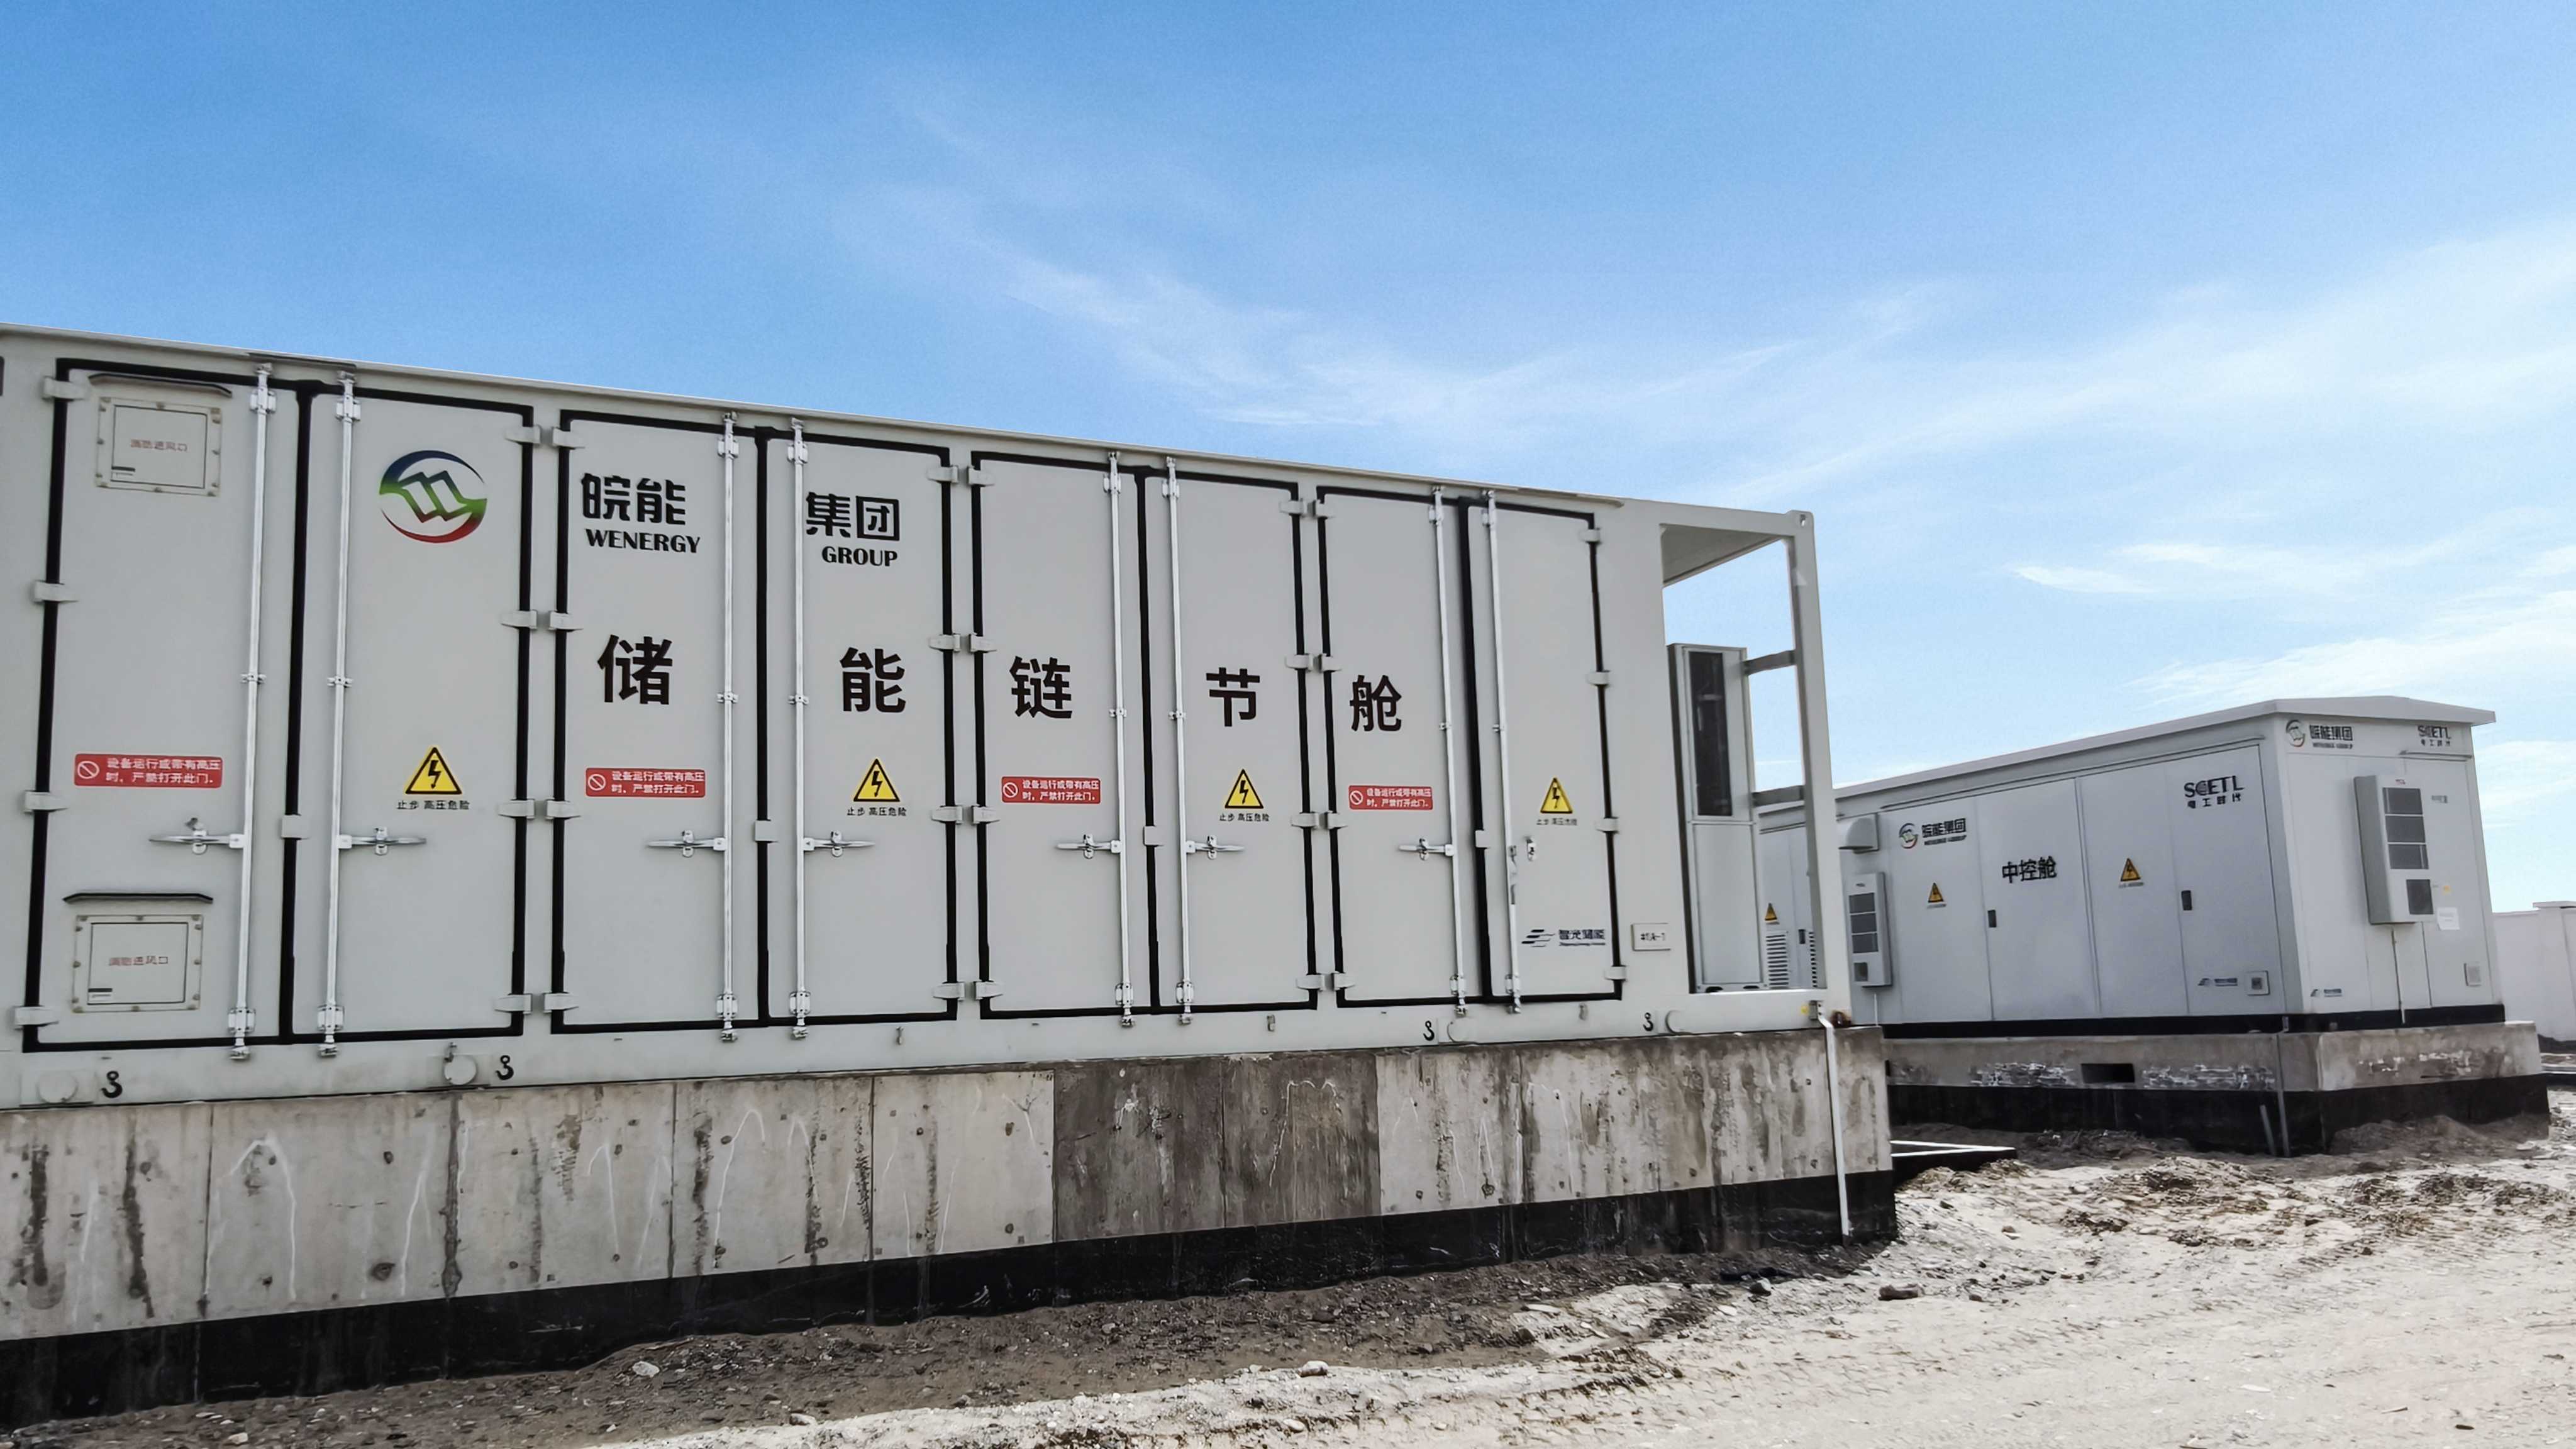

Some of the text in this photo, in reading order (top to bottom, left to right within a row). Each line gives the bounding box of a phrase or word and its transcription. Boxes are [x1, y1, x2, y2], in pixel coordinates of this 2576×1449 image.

[581, 473, 900, 541] 皖能 集团
[585, 528, 898, 567] WENERGY GROUP
[597, 634, 1402, 731] 储 能 链 节 舱
[2002, 855, 2058, 884] 中控舱
